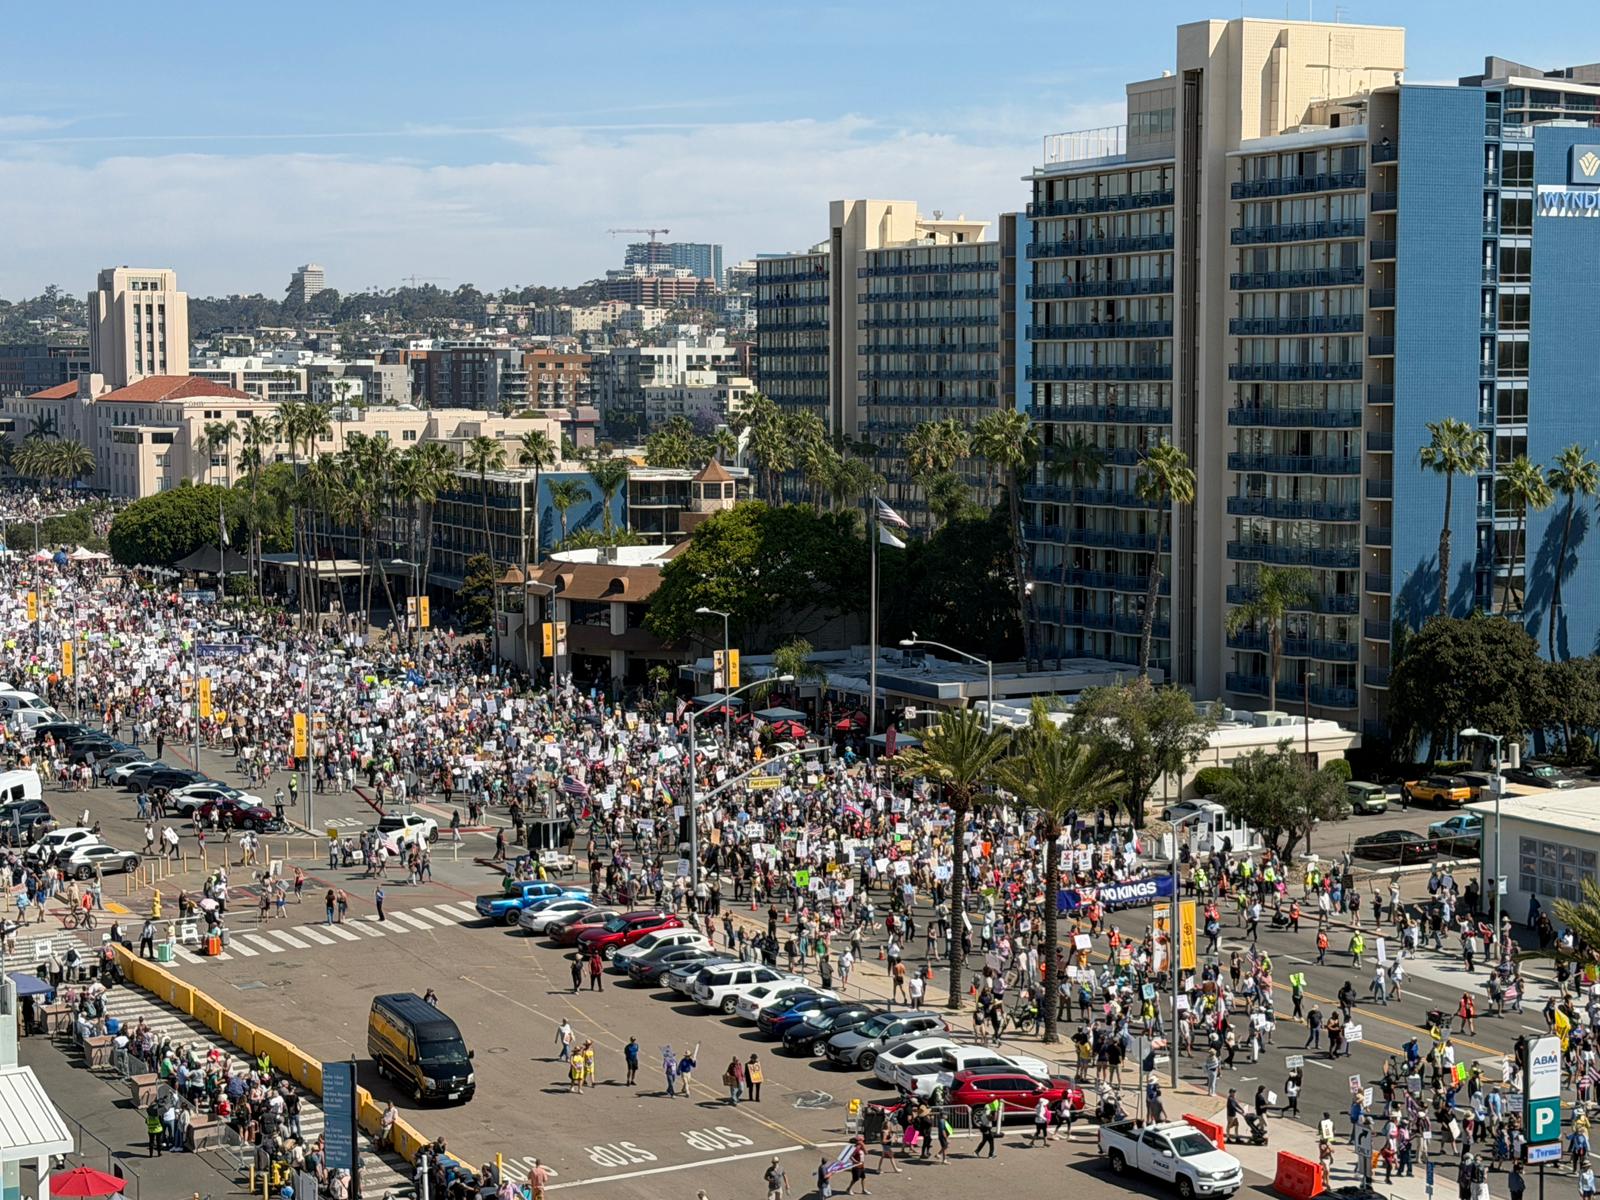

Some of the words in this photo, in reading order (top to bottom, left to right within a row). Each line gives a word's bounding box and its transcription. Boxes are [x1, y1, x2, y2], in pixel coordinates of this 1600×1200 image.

[1544, 192, 1600, 208] WYND
[1100, 888, 1116, 900] NO
[1117, 882, 1157, 900] KINGS
[1533, 1054, 1557, 1066] ABM
[1536, 1107, 1554, 1135] P
[680, 1126, 754, 1151] STOP
[584, 1141, 658, 1168] STOP
